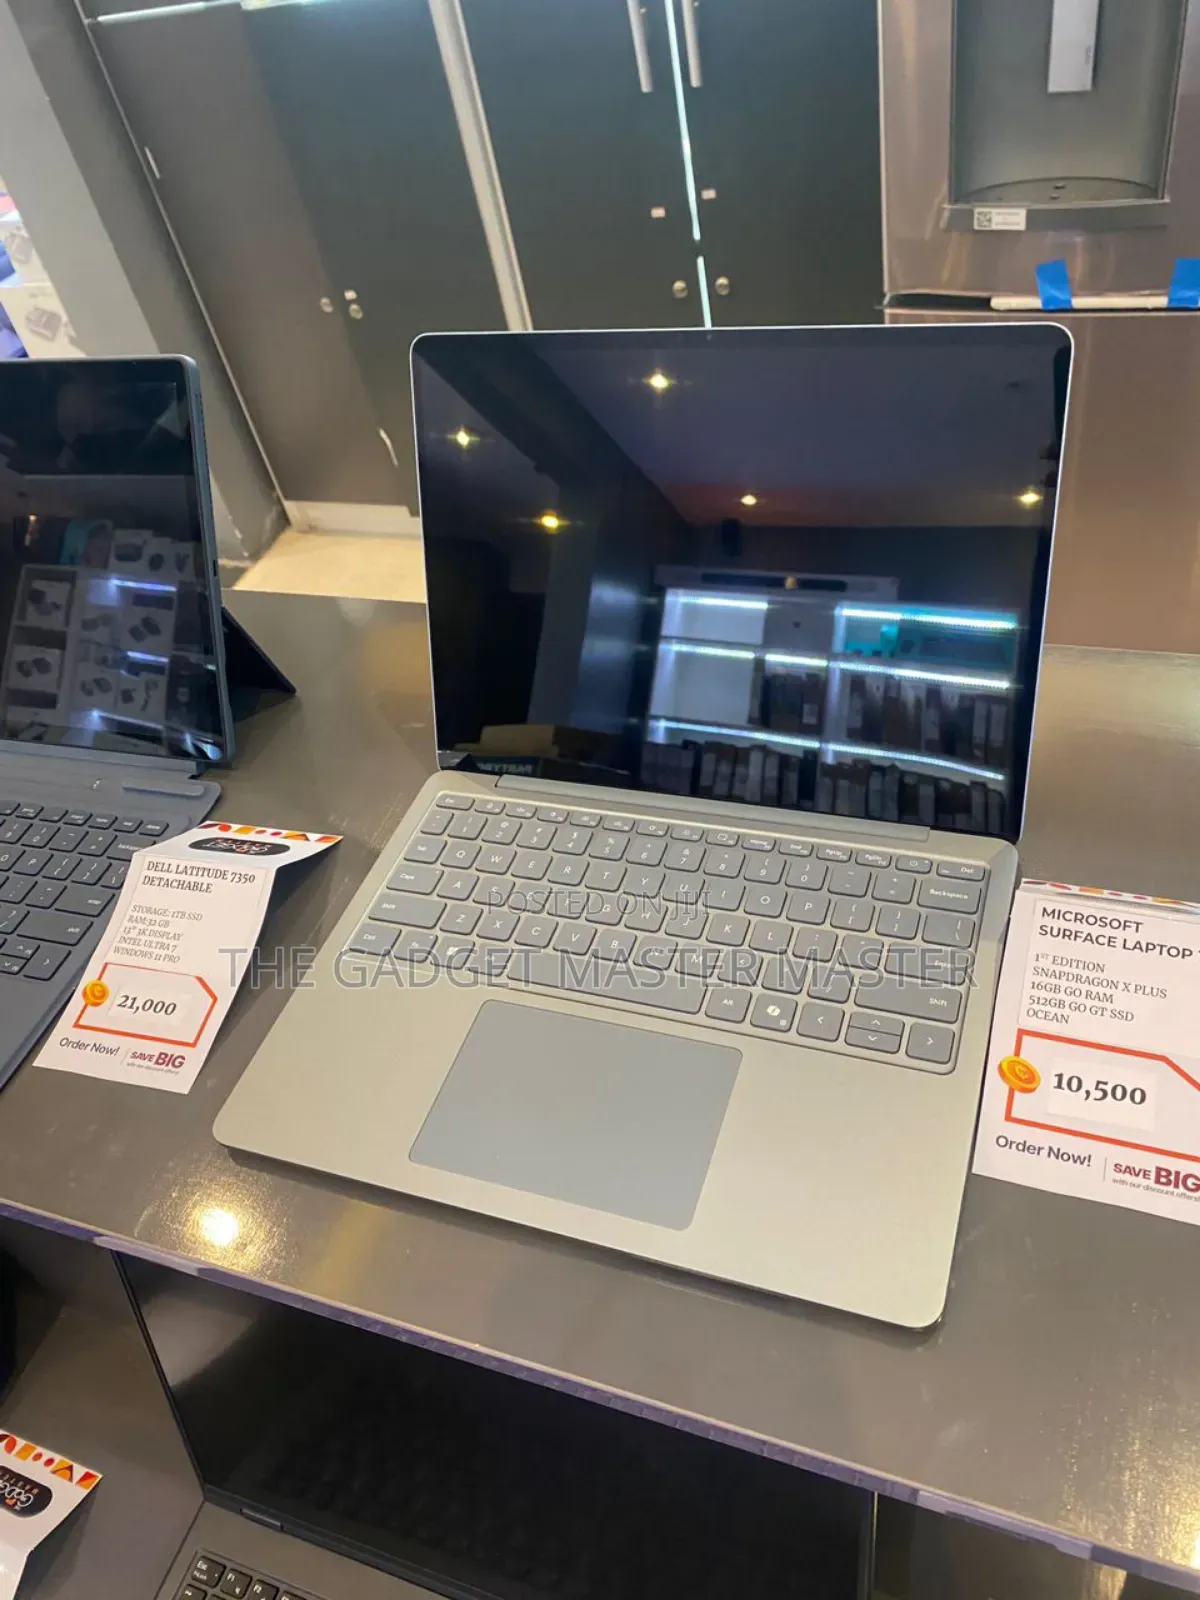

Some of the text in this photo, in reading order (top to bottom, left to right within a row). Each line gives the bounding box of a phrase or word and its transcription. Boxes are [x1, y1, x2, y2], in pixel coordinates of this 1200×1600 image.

[146, 860, 256, 884] DELL LATITUDE 7350
[142, 875, 214, 894] DETACHABLE
[131, 904, 170, 918] STORAGE:
[186, 911, 204, 921] SSD
[1041, 906, 1144, 933] MICROSOFT
[157, 919, 171, 928] GB
[118, 935, 144, 947] INTEL
[143, 939, 171, 950] ULTRA
[148, 929, 184, 941] DISPLAY
[1038, 923, 1194, 960] SURFACE LAPTOP
[113, 946, 153, 961] WINDOWS
[163, 954, 181, 964] PRO
[1051, 954, 1106, 973] EDITION
[1030, 980, 1114, 1004] 16GB GO RAM
[1032, 965, 1168, 999] SNAPDRAGON X PLUS
[117, 994, 178, 1016] 21,000
[929, 997, 948, 1007] Shift
[1028, 994, 1135, 1022] 512GB GO GT SSD
[1026, 1007, 1070, 1024] OCEAN
[59, 1036, 121, 1057] Order Now!
[130, 1050, 155, 1063] SAVE
[154, 1051, 186, 1070] BIG
[1053, 1072, 1147, 1106] 10,500
[995, 1134, 1093, 1167] Order Now!
[1112, 1162, 1200, 1194] SAVE BIG
[1142, 1184, 1175, 1197] discount
